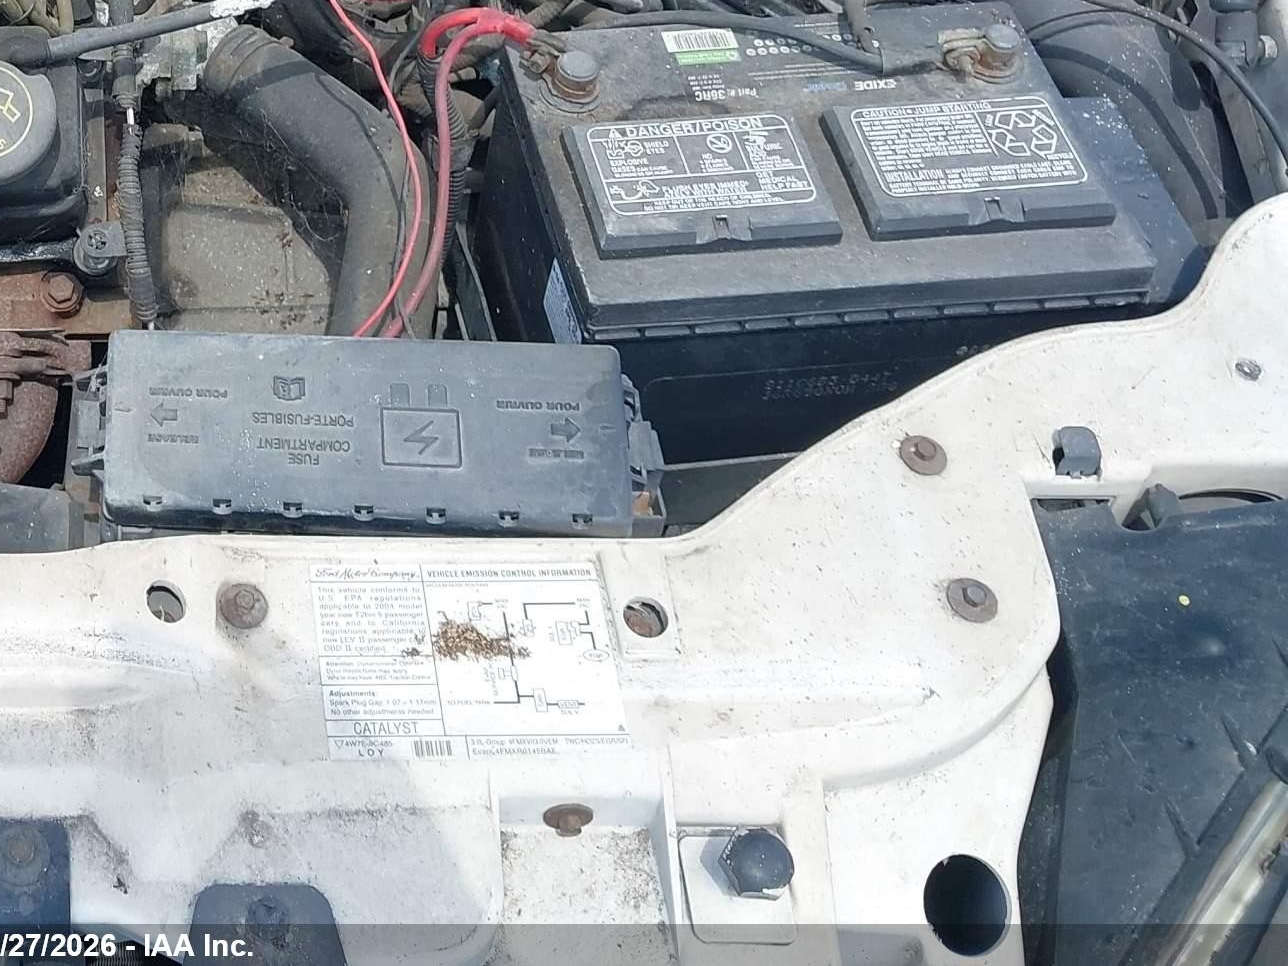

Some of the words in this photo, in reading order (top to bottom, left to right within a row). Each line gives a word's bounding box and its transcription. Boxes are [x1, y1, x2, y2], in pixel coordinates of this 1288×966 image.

[855, 79, 897, 91] EXIDE
[738, 87, 757, 97] Part
[862, 109, 906, 119] CAUTION
[913, 105, 940, 115] JUMP
[943, 101, 991, 113] STARTING
[626, 117, 763, 138] DANGER/POISON
[643, 140, 670, 149] SHIELD
[610, 157, 649, 167] EXPLOSIVE
[755, 171, 774, 179] GET
[884, 170, 945, 183] INSTALLATION
[758, 176, 799, 185] MEDICAL
[760, 182, 785, 191] HELP
[785, 180, 810, 189] FAST
[545, 401, 581, 412] POUR
[251, 411, 355, 429] PORTE-FUSIBLES
[256, 437, 352, 454] COMPARTMENT
[287, 452, 321, 467] FUSE
[427, 570, 459, 578] VEHICLE
[538, 568, 592, 576] INFORMATION
[370, 595, 422, 603] regulations
[319, 603, 360, 611] applicable
[384, 612, 423, 620] passenger
[322, 628, 367, 636] regulations
[372, 628, 414, 636] applicable
[368, 637, 407, 645] passenger
[329, 699, 350, 708] Spark
[351, 699, 367, 707] Plug
[342, 708, 361, 716] other
[362, 708, 406, 716] adjustments
[354, 721, 419, 735] CATALYST
